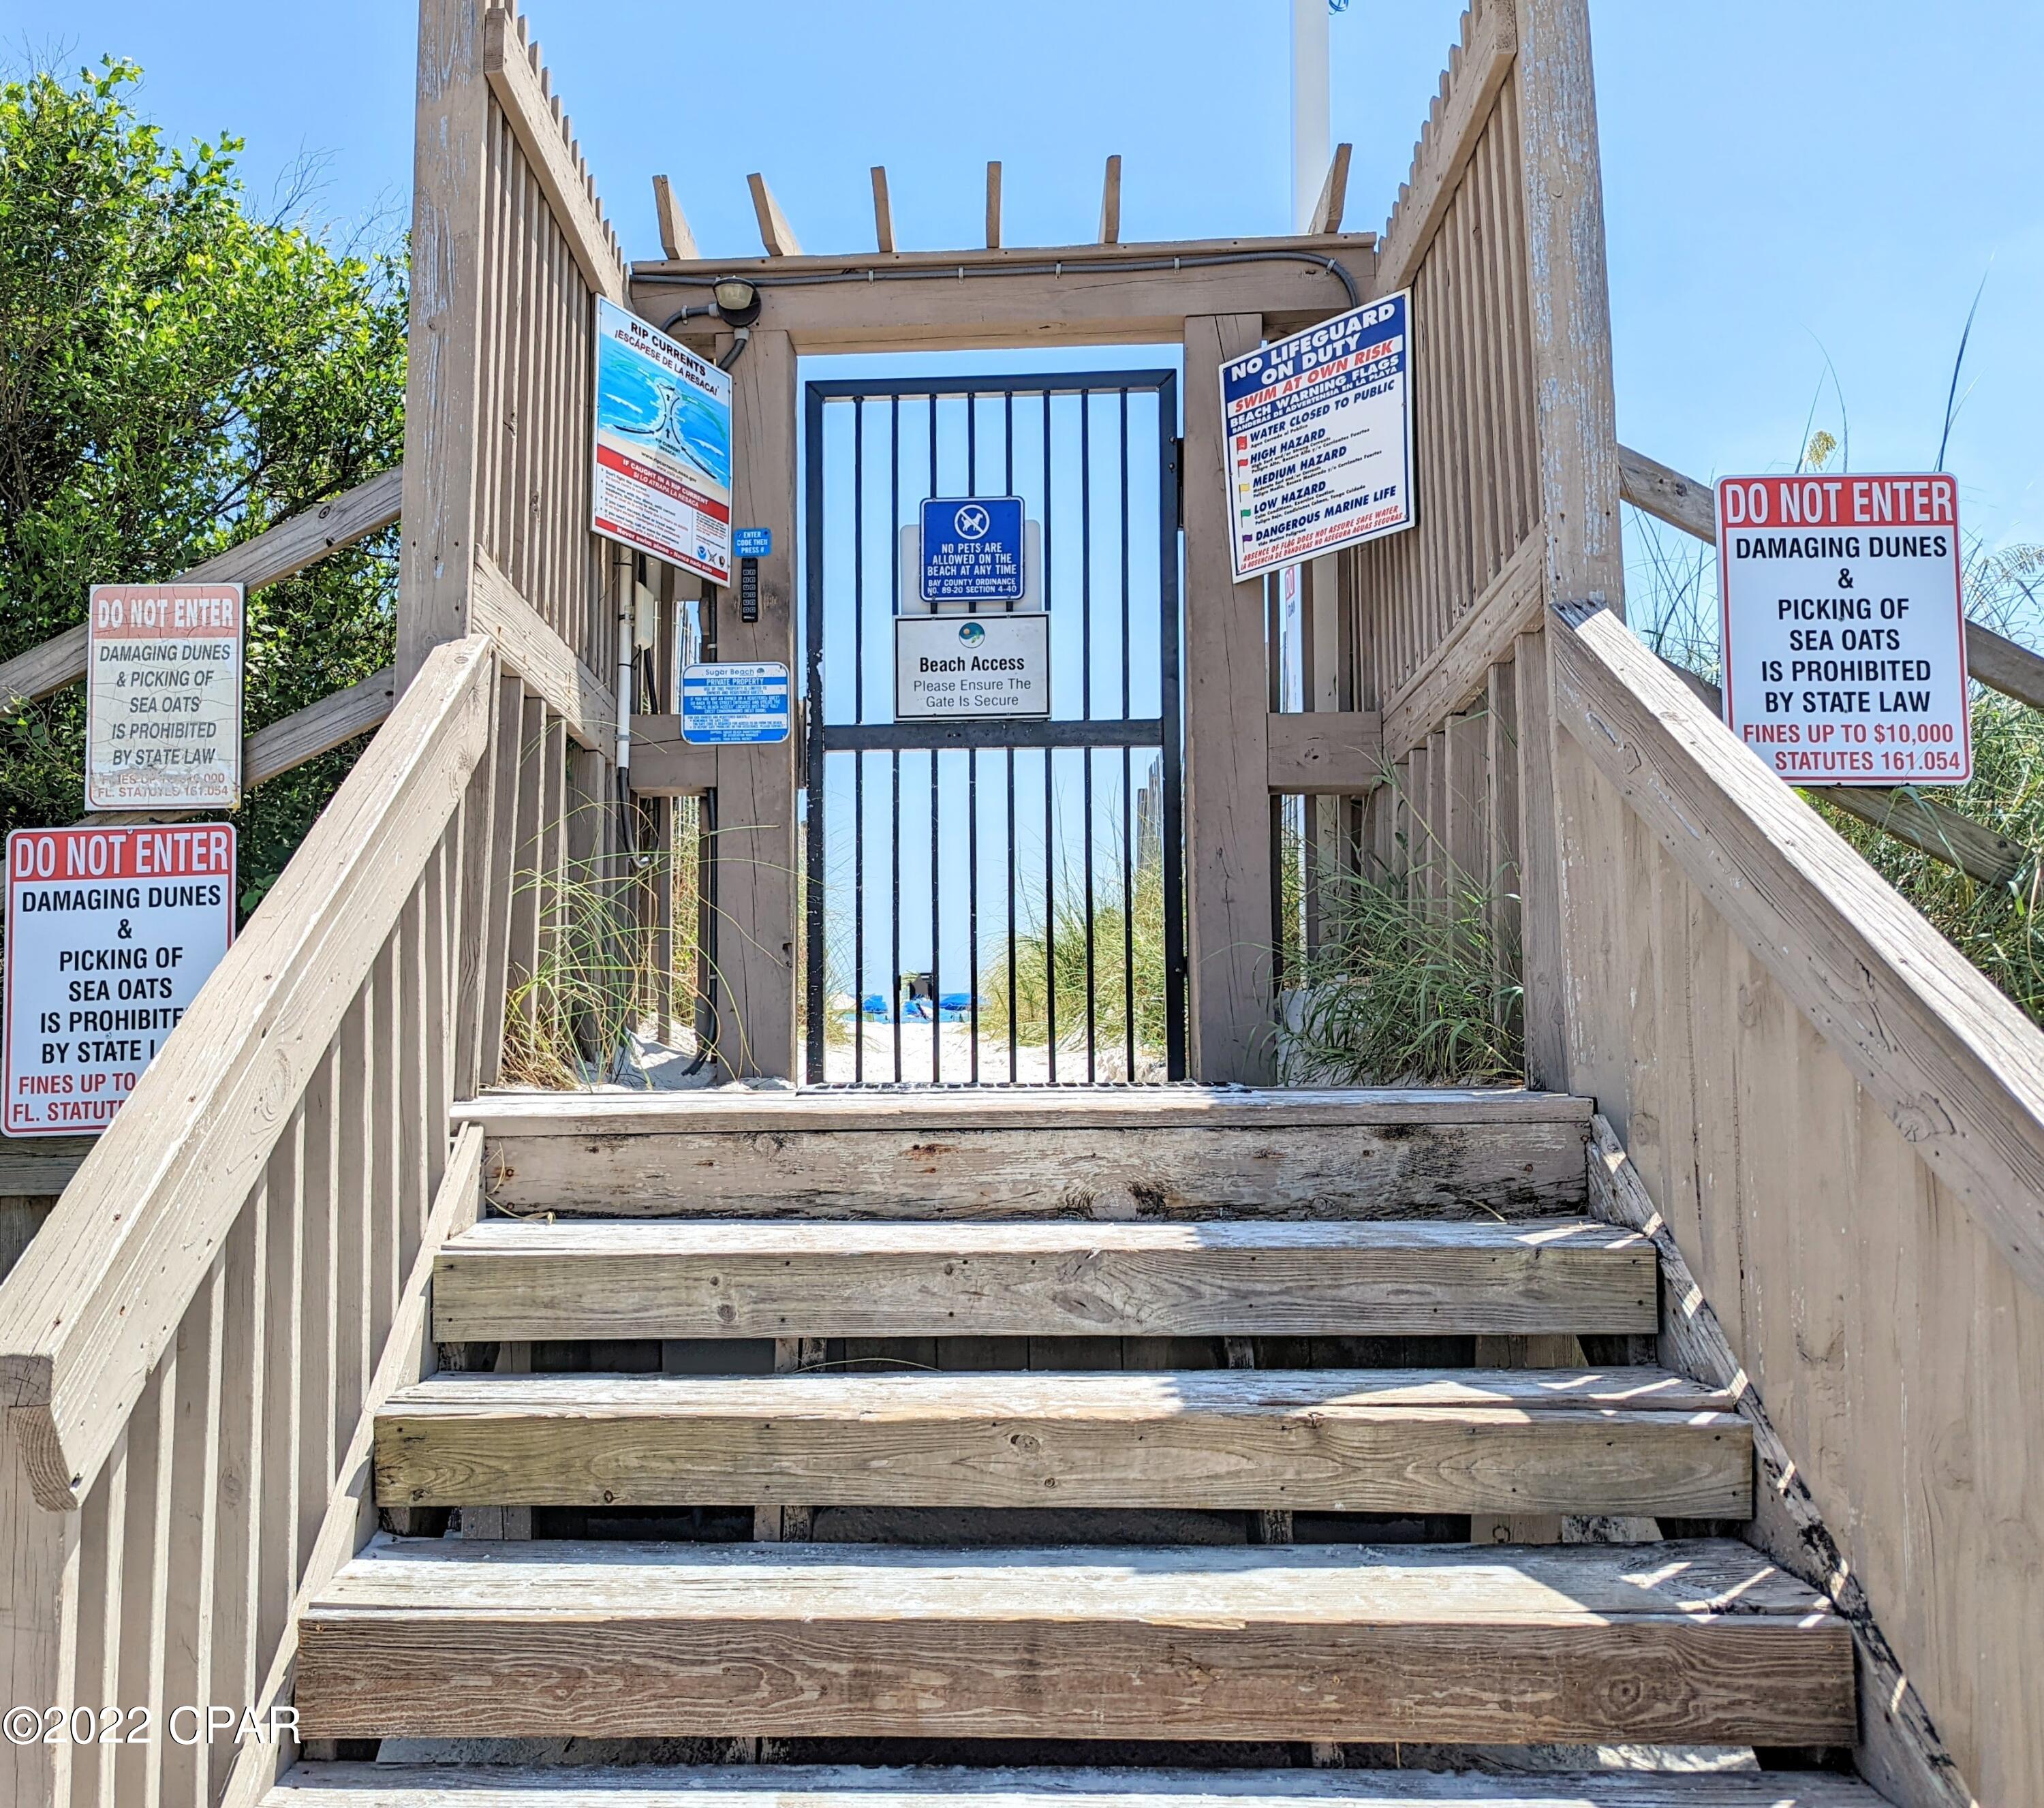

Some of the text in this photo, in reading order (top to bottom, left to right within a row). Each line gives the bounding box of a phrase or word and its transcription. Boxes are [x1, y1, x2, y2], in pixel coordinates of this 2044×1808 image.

[631, 322, 705, 376] RIP CURRENTS
[1231, 303, 1394, 381] NO LIFEGUARD
[662, 356, 672, 369] DE
[674, 363, 683, 376] LA
[1261, 332, 1360, 384] ON DUTY
[1235, 339, 1393, 412] SWIM AT OWN RISK
[1230, 355, 1398, 427] BEACH WARNING FLAGS
[1232, 366, 1397, 433] BANDERAS DE ADVERTENSIA EN LA PLAYA
[1250, 379, 1394, 442] WATER CLOSED TO PUBLIC
[1250, 428, 1325, 464] HIGH HAZARD
[1252, 446, 1346, 488] MEDIUM HAZARD
[630, 463, 656, 478] CAUGHT
[657, 475, 664, 483] IN
[670, 482, 681, 490] RIP
[681, 488, 708, 504] CURRENT
[639, 474, 648, 482] LO
[648, 479, 669, 493] ATRAPA
[670, 488, 677, 497] LA
[677, 493, 698, 507] RESACA
[1254, 480, 1325, 514] LOW HAZARD
[1726, 481, 1953, 524] DO NOT ENTER
[1256, 485, 1396, 541] DANGEROUS MARINE LIFE
[617, 526, 634, 538] Never
[636, 535, 651, 546] swim
[653, 543, 669, 553] alone
[673, 551, 689, 562] Nunca
[1243, 546, 1269, 561] ABSENCE
[1271, 544, 1279, 552] OF
[1297, 532, 1314, 544] DOES
[1314, 527, 1327, 537] NOT
[1328, 518, 1354, 533] ASSURE
[1355, 512, 1372, 525] SAFE
[1375, 505, 1398, 518] WATER
[942, 542, 1002, 554] NO PETS ARE
[1736, 535, 1947, 559] DAMAGING DUNES
[927, 565, 1017, 576] BEACH AT ANY TIME
[933, 554, 1012, 565] ALLOWED ON THE
[1838, 568, 1854, 589] &
[98, 598, 234, 628] DO NOT ENTER
[1778, 598, 1909, 620] PICKING OF
[1789, 629, 1900, 651] SEA OATS
[100, 644, 230, 661] DAMAGING DUNES
[920, 656, 1025, 672] Beach Access
[117, 670, 213, 687] & PICKING OF
[1761, 660, 1930, 682] IS PROHIBITED
[914, 678, 1031, 691] Please Ensure The
[130, 697, 200, 713] SEA OATS
[927, 695, 1019, 707] Gate Is Secure
[1765, 691, 1930, 713] BY STATE LAW
[112, 722, 217, 739] IS PROHIBITED
[1744, 723, 1953, 745] FINES UP TO $10,000
[113, 749, 215, 765] BY STATE LAW
[1775, 751, 1960, 770] STATUTES 161.054
[16, 831, 228, 877] DO NOT ENTER
[22, 885, 221, 911] DAMAGING DUNES
[118, 918, 132, 939] &
[60, 947, 183, 971] PICKING OF
[69, 978, 172, 1001] SEA OATS
[41, 1008, 189, 1033] IS PROHIBITE
[42, 1044, 69, 1063] BY
[78, 1040, 141, 1062] STATE
[19, 1073, 136, 1095] FINES UP TO
[14, 1104, 40, 1122] FL.
